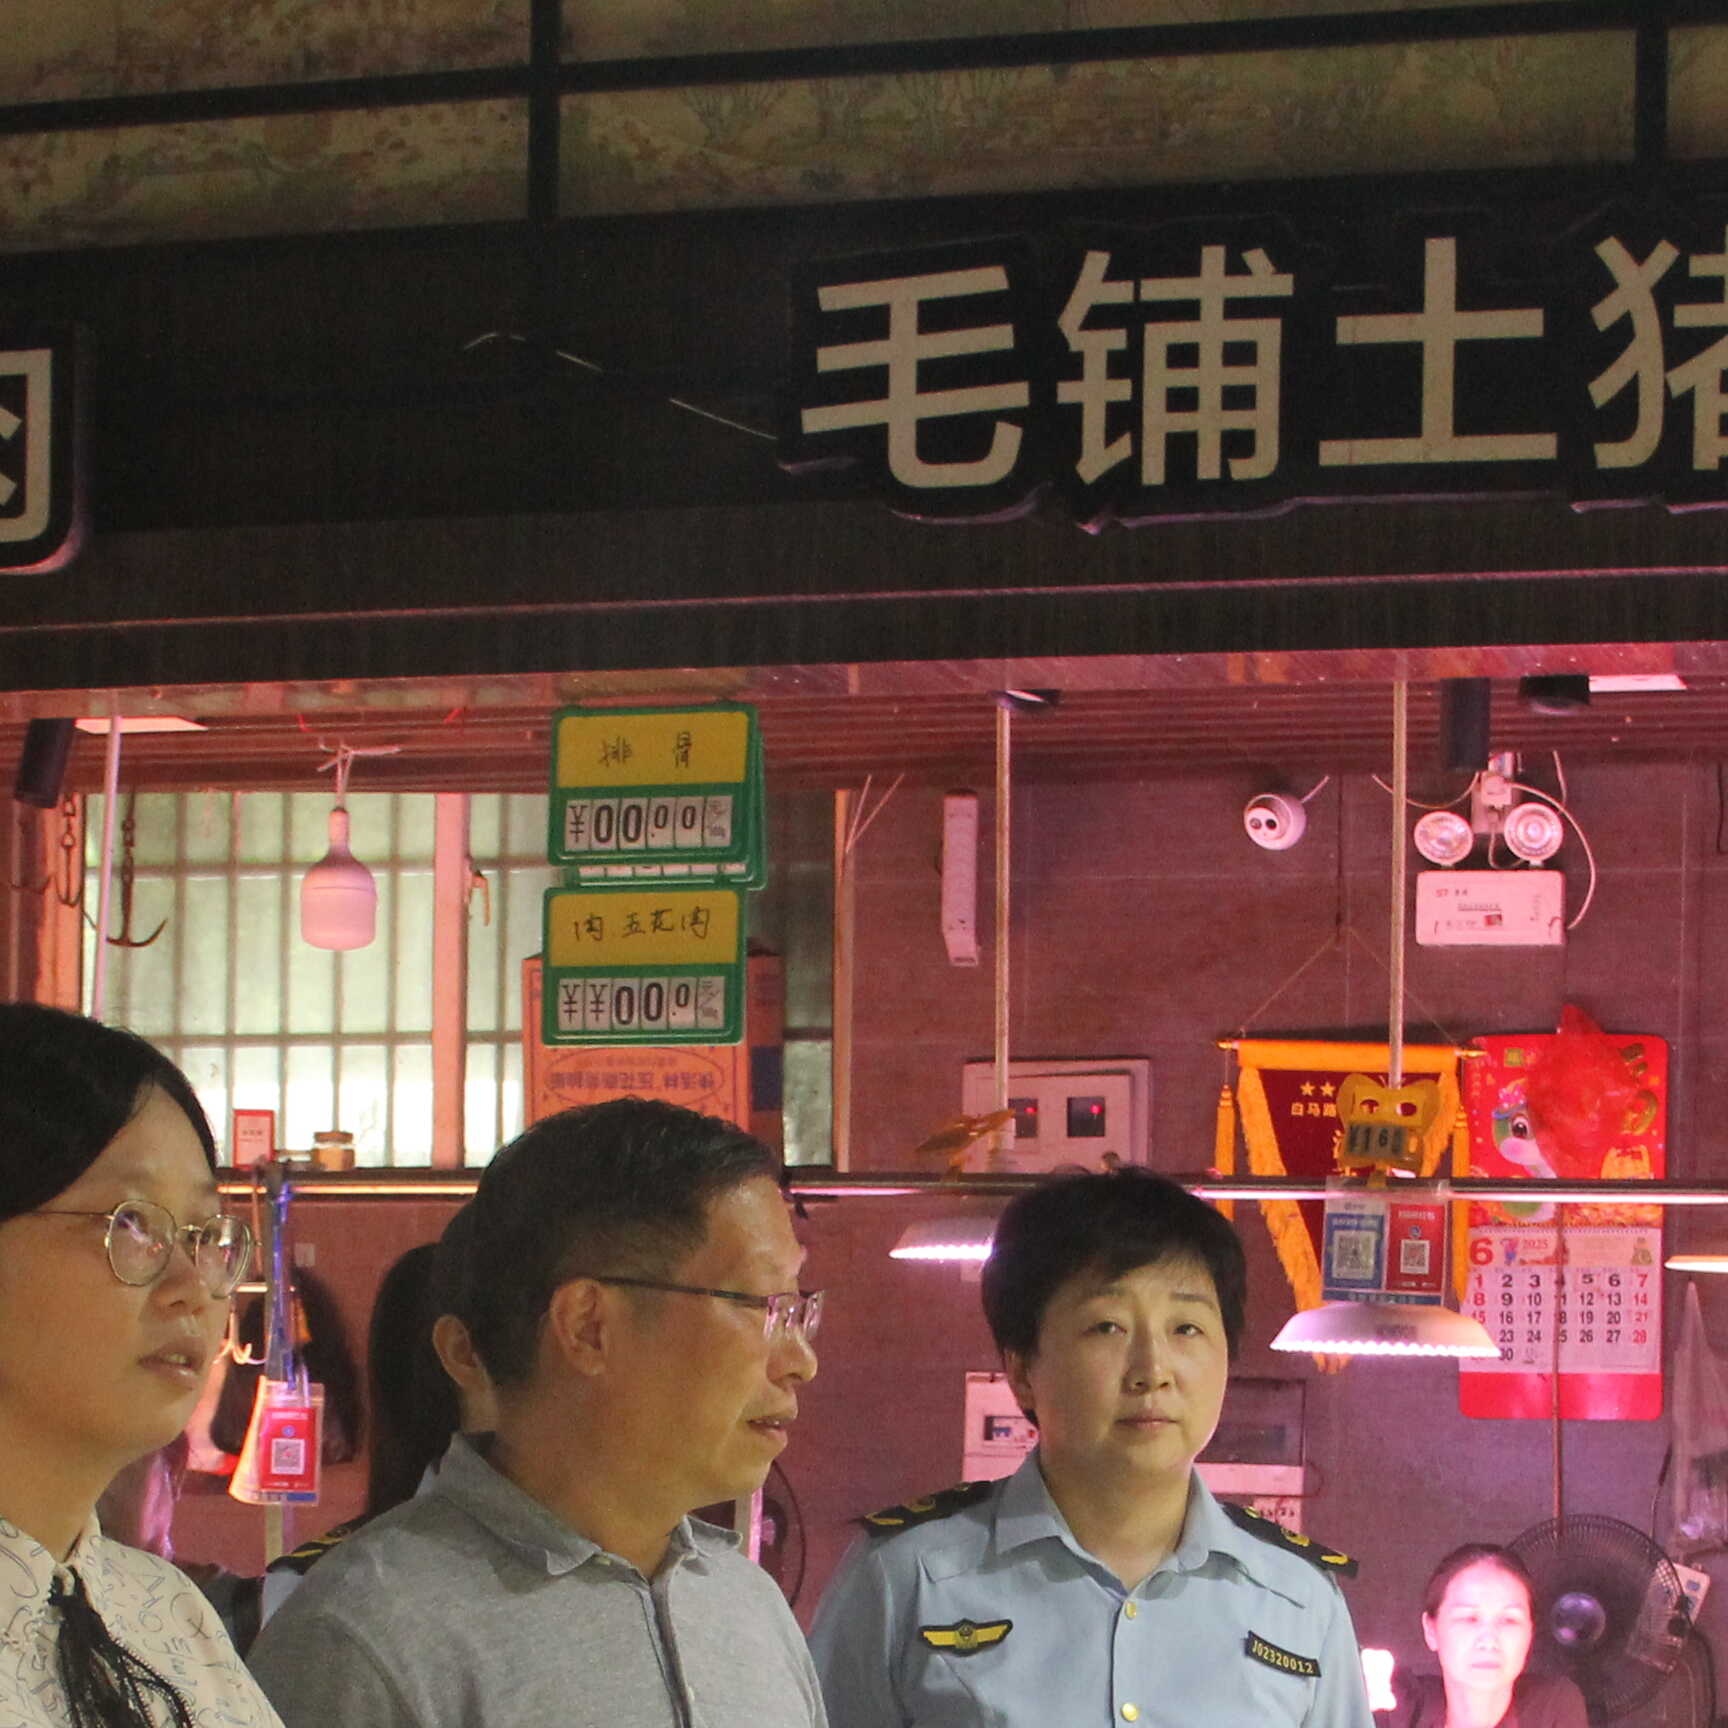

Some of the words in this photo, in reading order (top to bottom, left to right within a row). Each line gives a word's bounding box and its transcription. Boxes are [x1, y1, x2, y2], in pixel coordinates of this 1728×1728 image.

[1470, 1238, 1493, 1265] 6
[1476, 1274, 1483, 1288] 1
[1502, 1274, 1513, 1288] 2
[1530, 1274, 1541, 1288] 3
[1582, 1274, 1593, 1284] 5
[1609, 1274, 1620, 1287] 6
[1637, 1274, 1648, 1287] 7
[1474, 1293, 1485, 1306] 8
[1501, 1293, 1513, 1306] 9
[1528, 1293, 1542, 1306] 10
[1580, 1293, 1594, 1306] 12
[1608, 1293, 1621, 1306] 13
[1634, 1293, 1648, 1306] 14
[1500, 1312, 1513, 1325] 16
[1528, 1312, 1541, 1325] 17
[1580, 1312, 1593, 1325] 19
[1607, 1312, 1621, 1325] 20
[1500, 1330, 1514, 1343] 23
[1527, 1330, 1541, 1343] 24
[1580, 1330, 1593, 1343] 26
[1607, 1330, 1620, 1343] 27
[1252, 1640, 1314, 1673] J02320012
